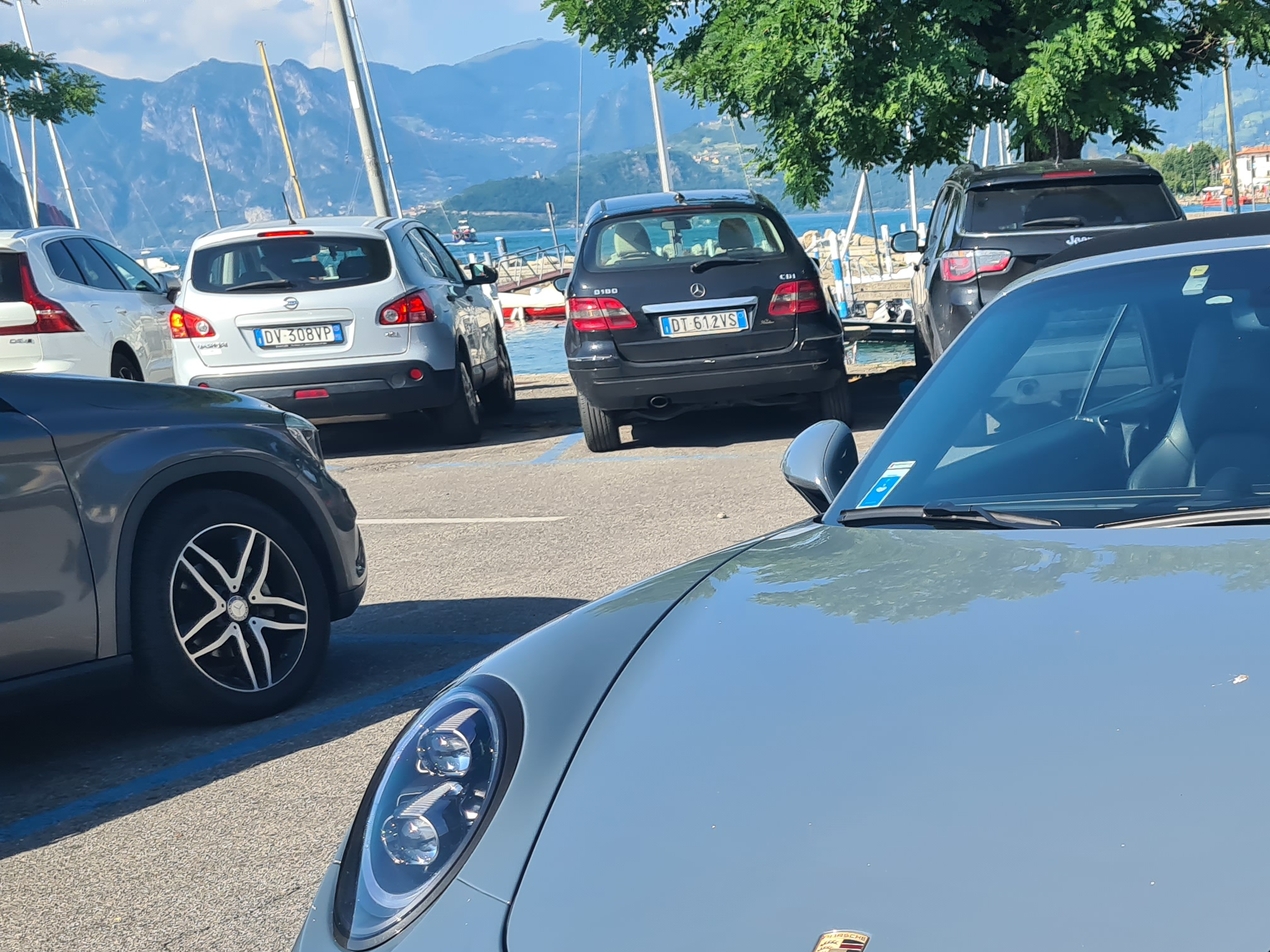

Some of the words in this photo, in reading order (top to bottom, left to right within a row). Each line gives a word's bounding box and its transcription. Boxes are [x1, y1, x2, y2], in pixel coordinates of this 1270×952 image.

[1066, 234, 1095, 245] Jee
[671, 317, 687, 333] DT
[693, 313, 737, 330] 612VS
[264, 328, 281, 344] DV
[287, 326, 332, 342] 308VP
